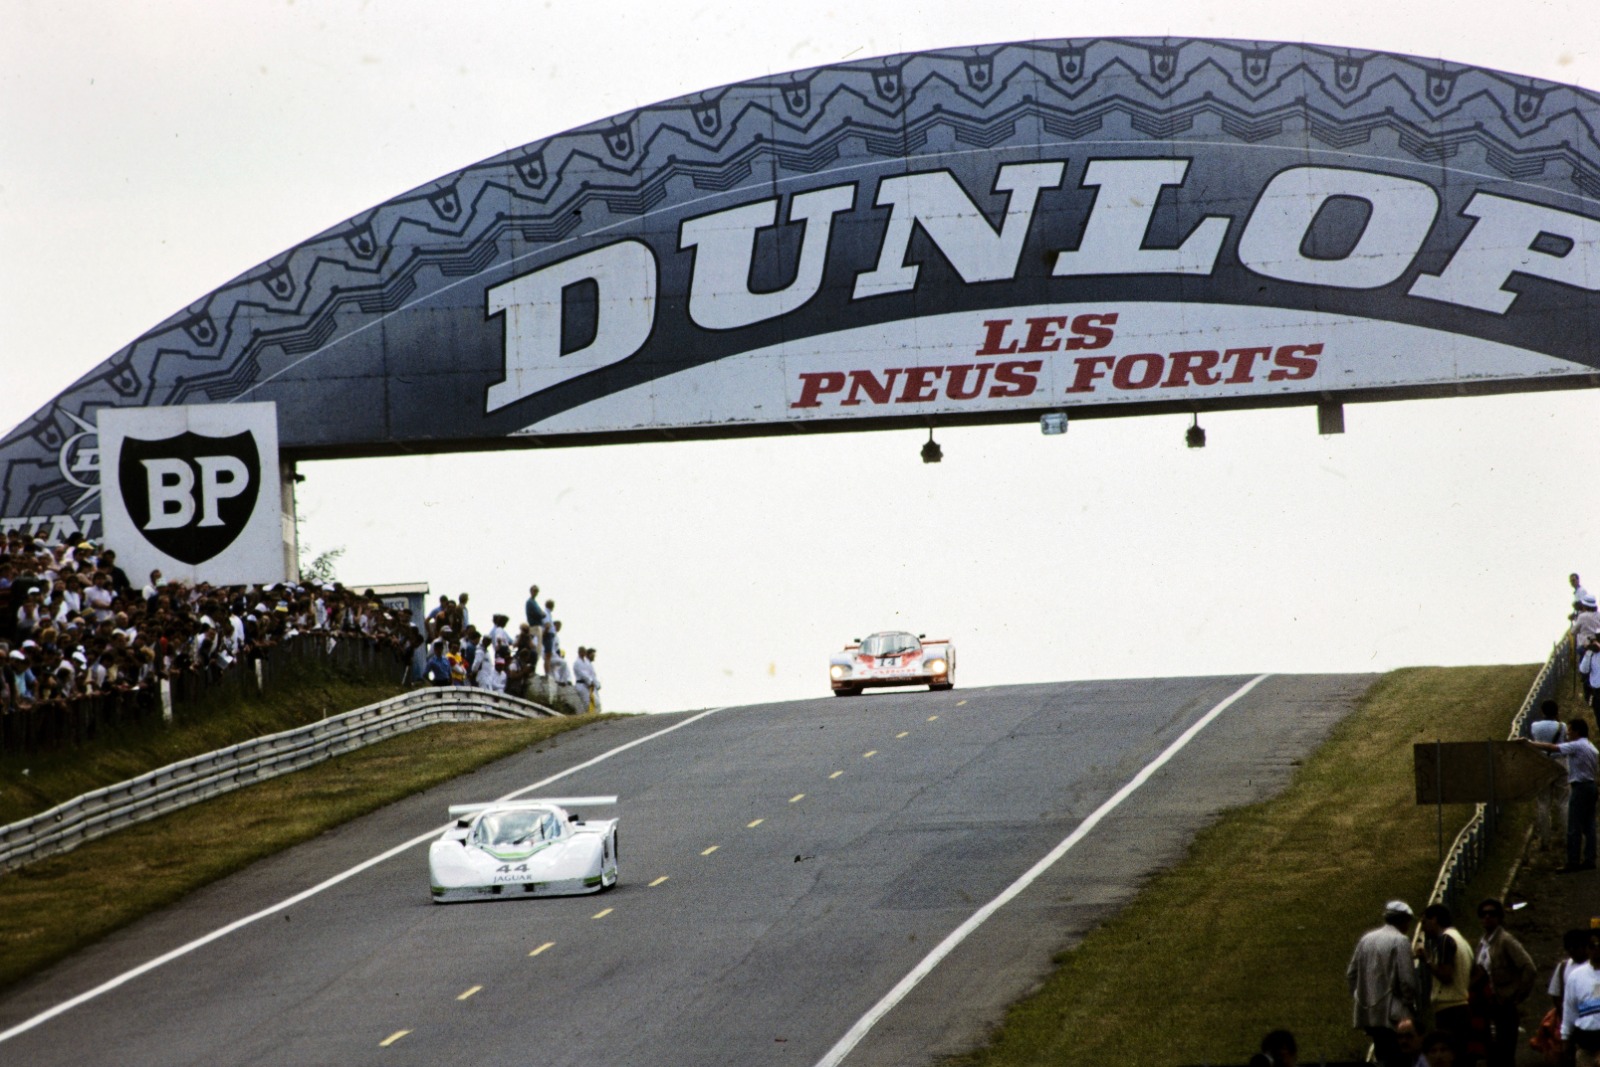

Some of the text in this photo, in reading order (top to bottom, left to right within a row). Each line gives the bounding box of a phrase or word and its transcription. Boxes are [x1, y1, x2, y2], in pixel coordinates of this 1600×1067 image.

[486, 159, 1600, 414] DUNLOP
[976, 313, 1119, 356] LES
[790, 343, 1325, 408] PNEUS FORTS
[139, 455, 249, 530] BP
[879, 658, 896, 667] 14
[493, 874, 533, 883] JAGUAR
[495, 863, 531, 874] 44
